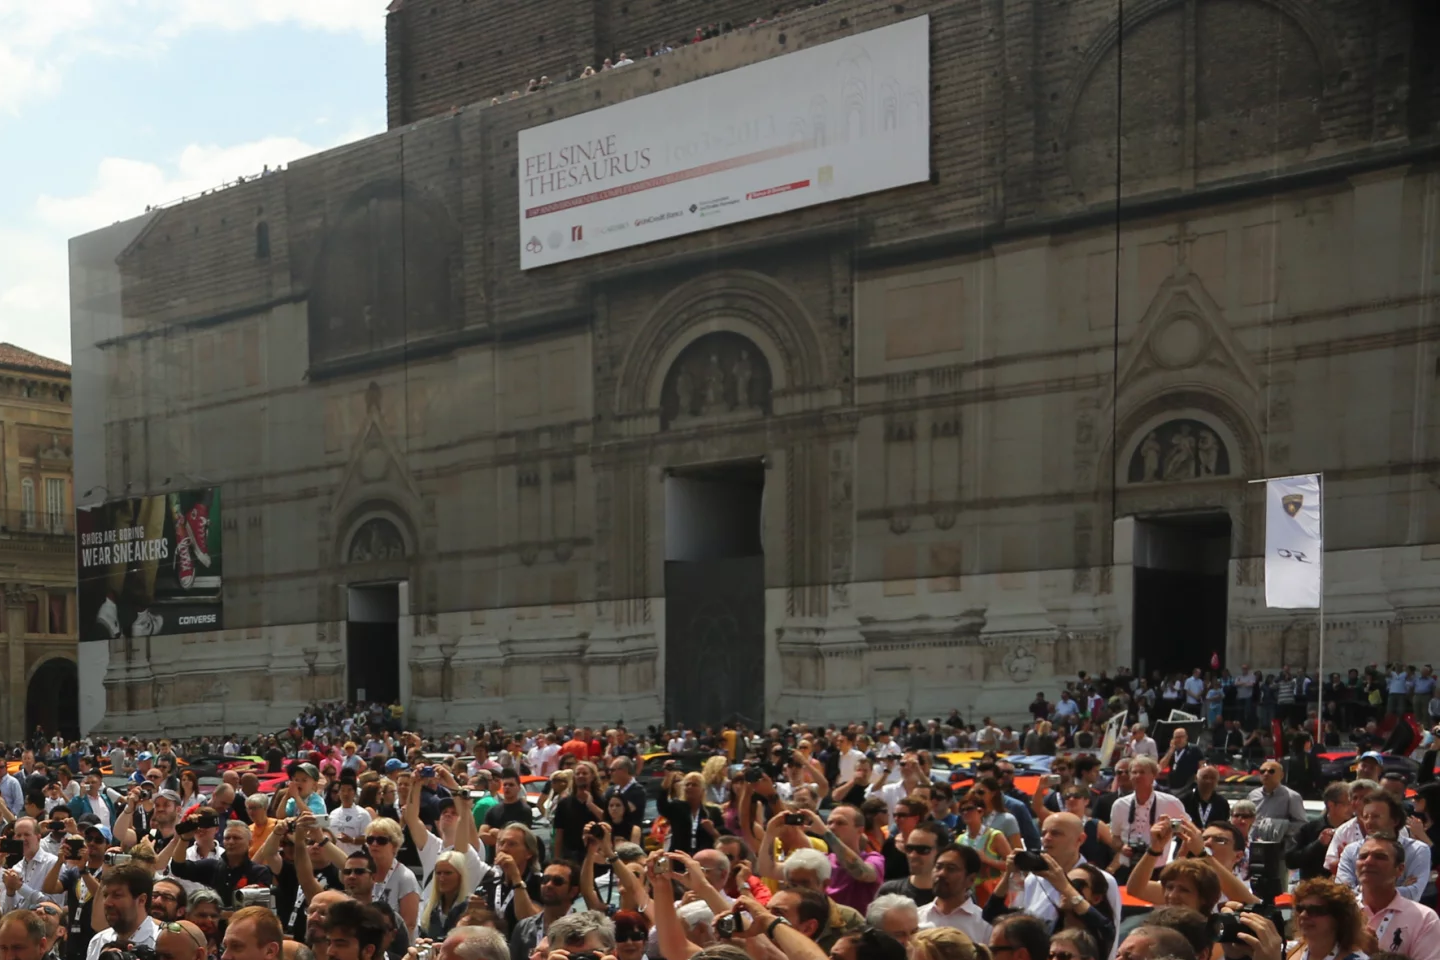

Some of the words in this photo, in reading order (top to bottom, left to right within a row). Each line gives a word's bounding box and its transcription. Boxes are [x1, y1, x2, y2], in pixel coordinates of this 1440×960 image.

[525, 134, 617, 177] FELSINAE
[525, 147, 651, 197] THESAURUS
[81, 531, 103, 546] SHOES
[104, 529, 117, 543] ARE
[119, 526, 145, 541] BORING
[82, 547, 111, 567] WEAR
[113, 538, 169, 564] SNEAKERS
[179, 614, 217, 625] CONVERSE
